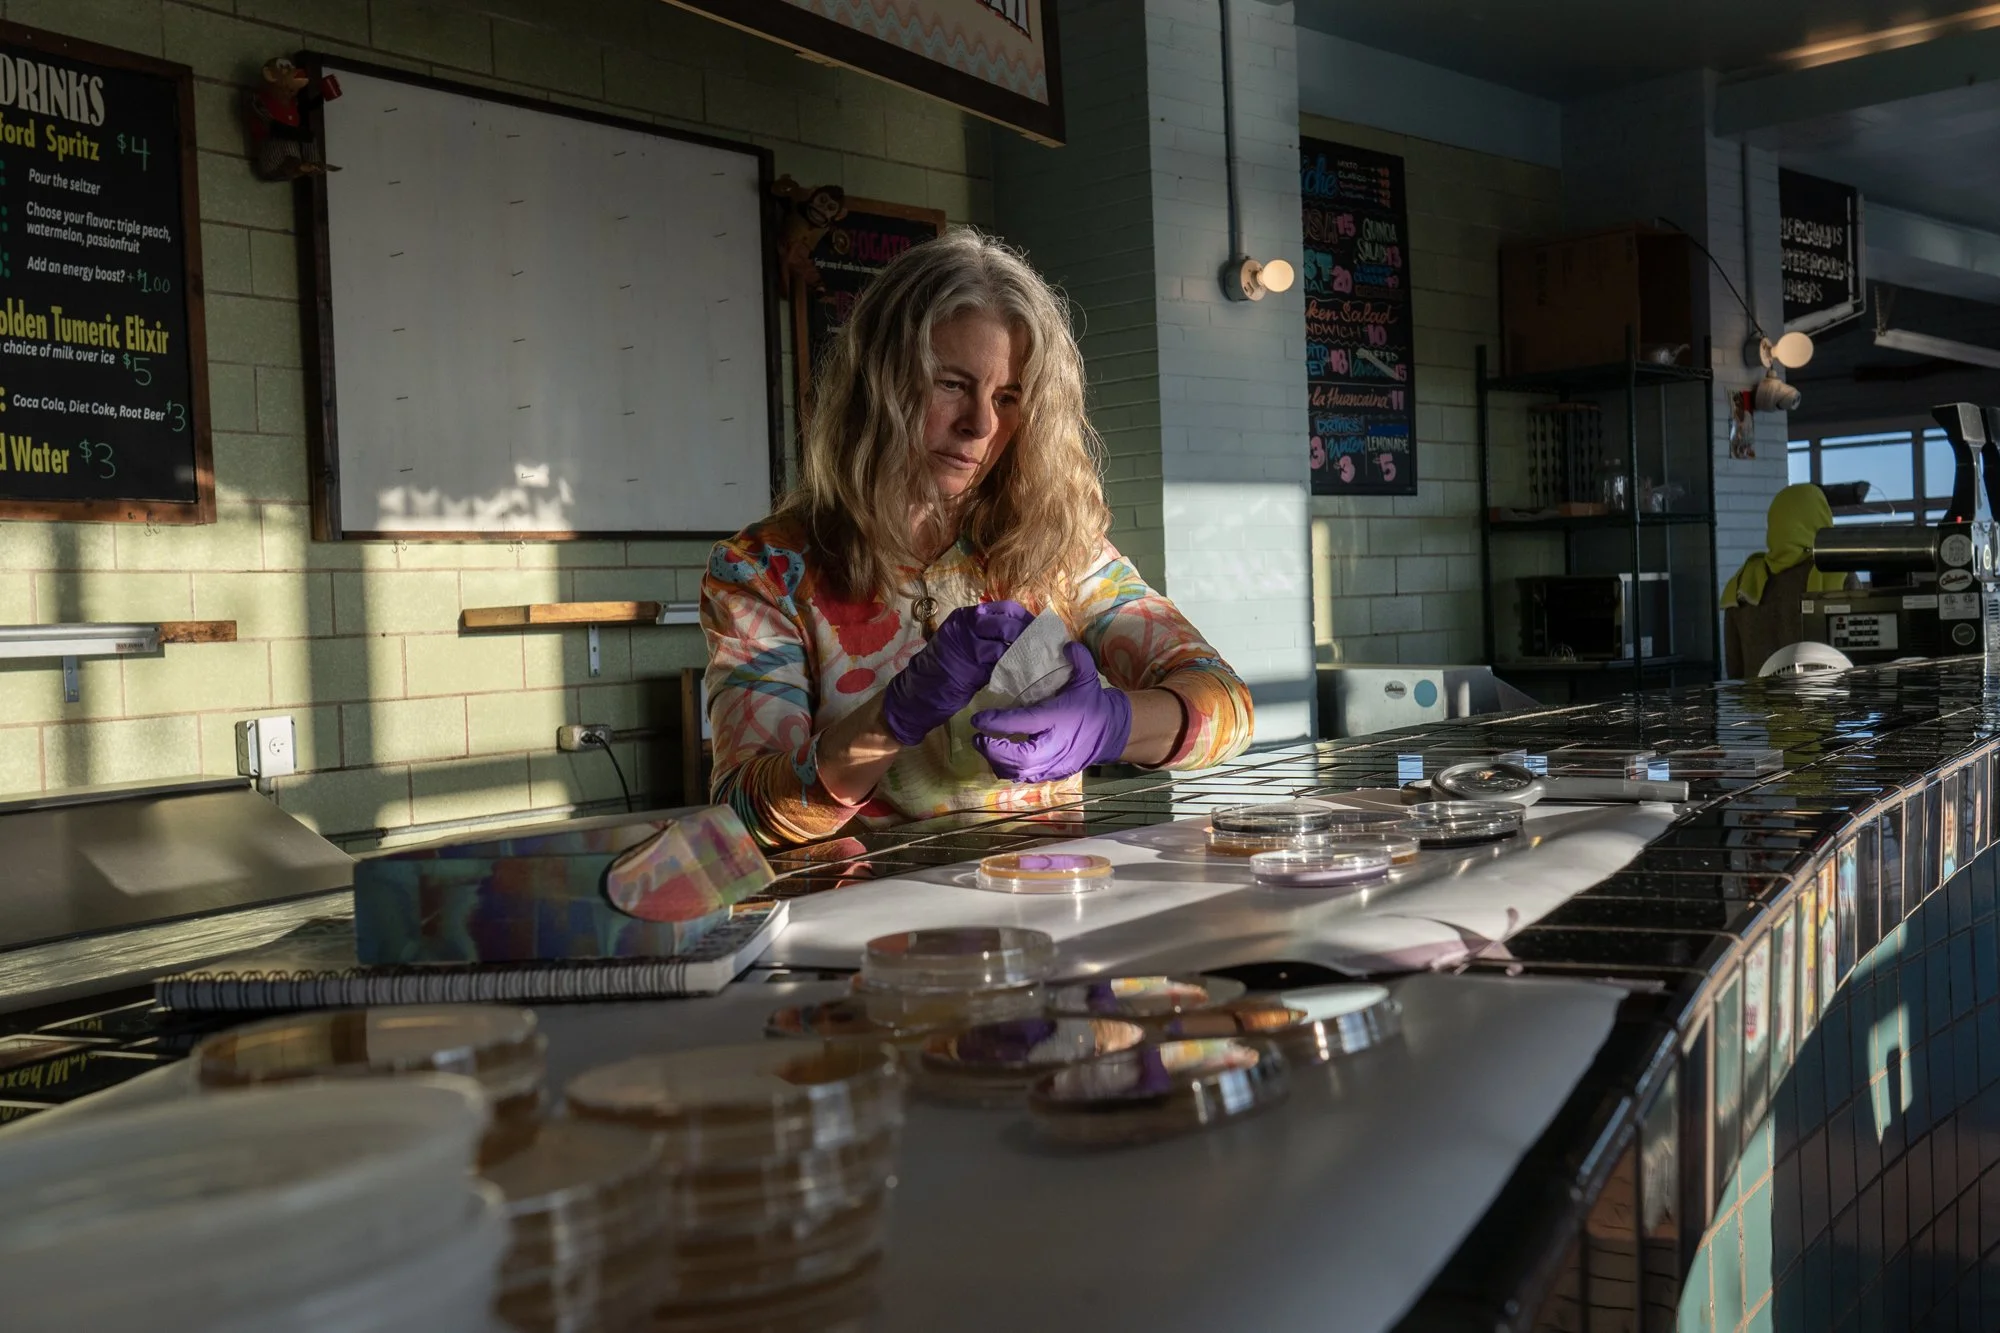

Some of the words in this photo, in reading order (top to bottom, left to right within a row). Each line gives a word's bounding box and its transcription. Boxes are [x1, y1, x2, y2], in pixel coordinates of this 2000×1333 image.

[0, 53, 105, 127] DRINKS
[45, 124, 100, 162] Spritz
[28, 168, 51, 187] Pour
[51, 174, 68, 190] the
[69, 177, 101, 196] seltzer
[26, 201, 62, 221] Choose
[63, 210, 84, 228] your
[86, 211, 116, 232] flavor:
[117, 218, 141, 235] triple
[141, 224, 172, 244] peach,
[26, 222, 85, 247] watermelon,
[86, 231, 140, 254] passionfruit
[1362, 217, 1398, 243] QUINOA
[27, 256, 48, 273] Add
[48, 262, 62, 274] an
[62, 263, 94, 283] energy
[95, 265, 125, 283] boost?
[1340, 301, 1399, 324] Salad
[51, 305, 121, 349] Tumeric
[125, 315, 170, 355] Elixir
[3, 339, 38, 357] choice
[39, 342, 52, 358] of
[52, 344, 74, 361] milk
[75, 352, 99, 364] over
[100, 350, 116, 365] ice
[122, 351, 152, 386] $5
[13, 394, 39, 409] Coca
[41, 397, 67, 415] Cola,
[69, 400, 90, 415] Diet
[91, 402, 118, 420] Coke,
[119, 405, 142, 420] Root
[143, 407, 166, 422] Beer
[10, 434, 70, 475] Water
[79, 438, 117, 480] $3
